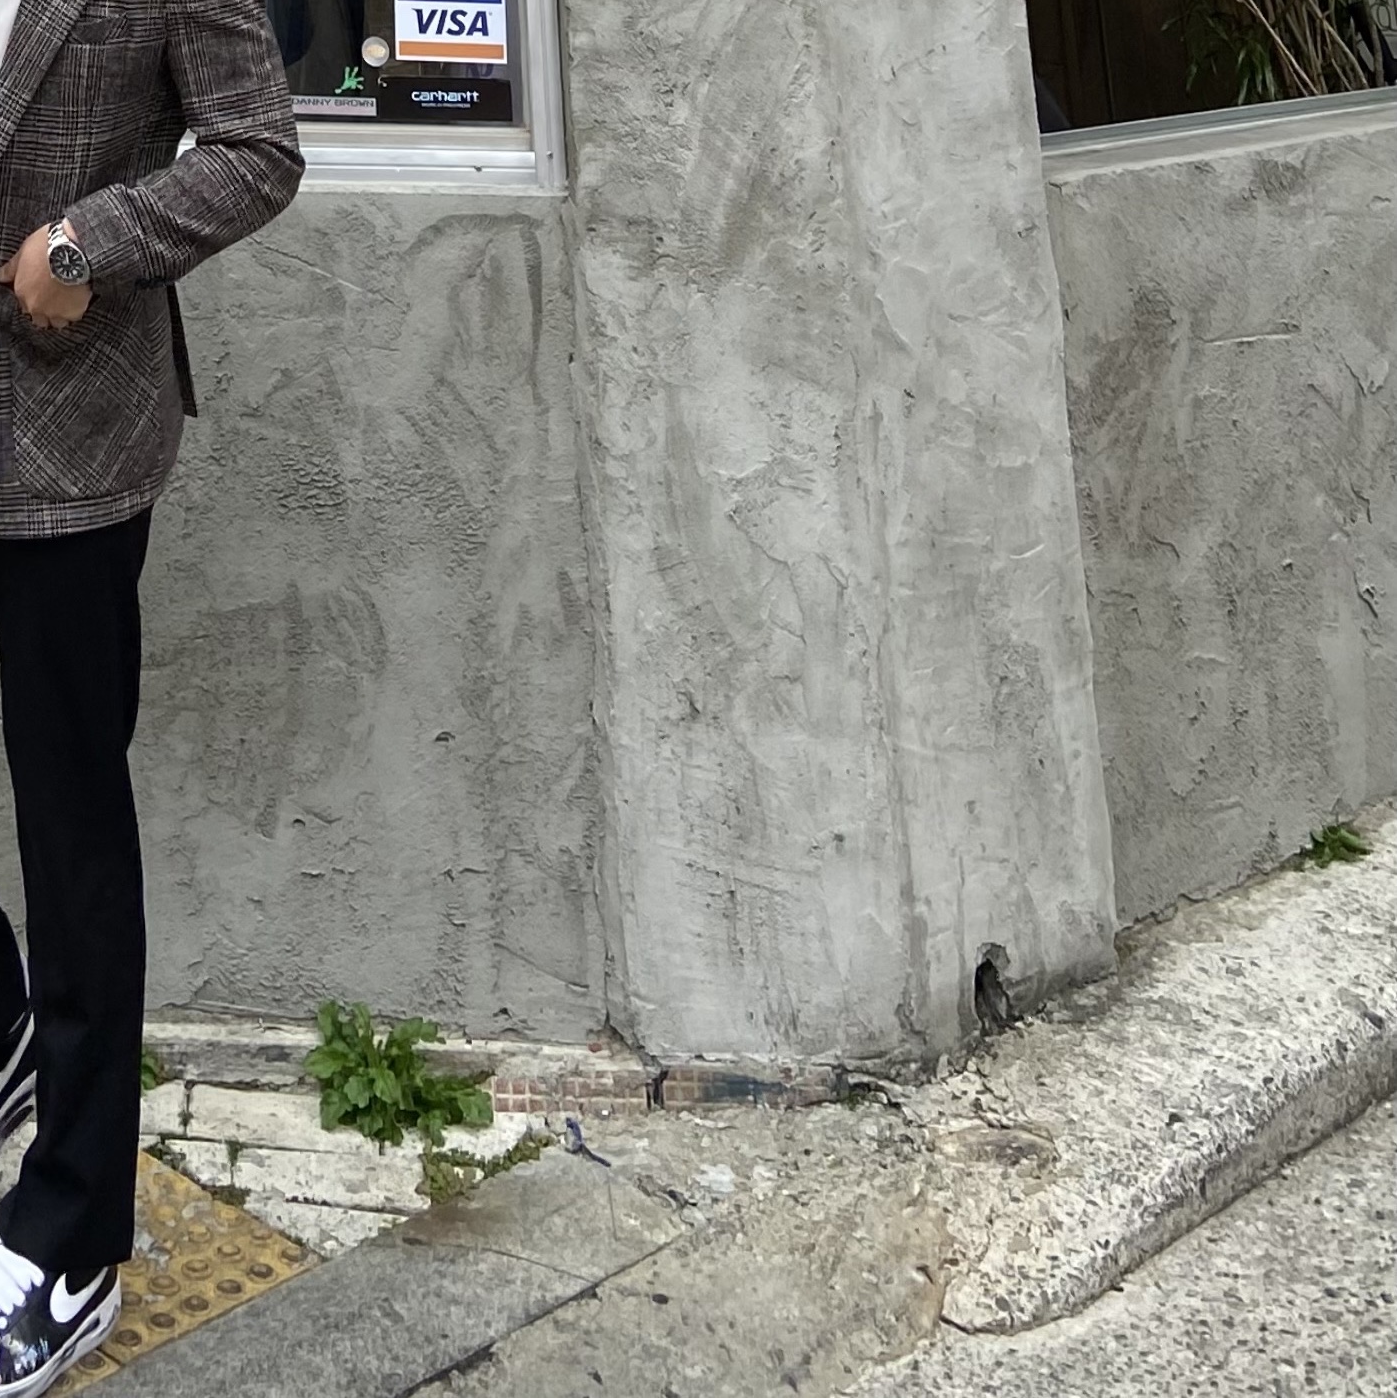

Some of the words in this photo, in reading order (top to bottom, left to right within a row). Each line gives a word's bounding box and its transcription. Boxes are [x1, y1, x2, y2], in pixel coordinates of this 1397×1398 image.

[411, 8, 490, 37] VISA
[334, 98, 374, 108] BROWN
[411, 90, 479, 103] carhartt
